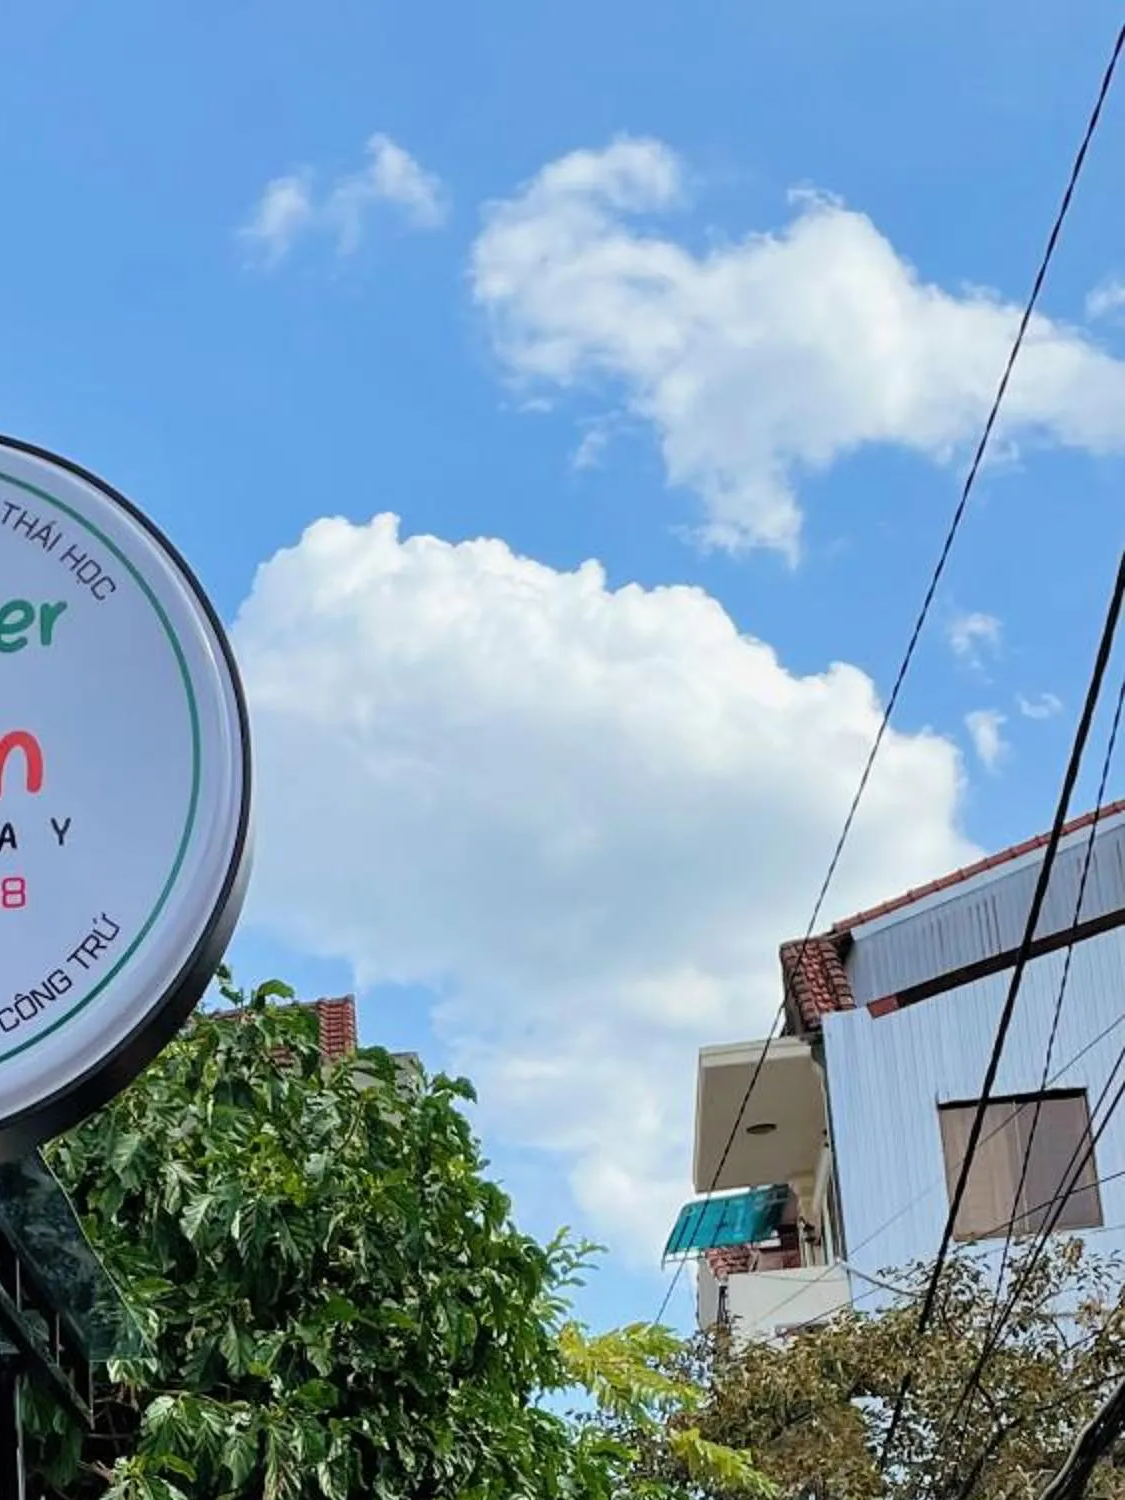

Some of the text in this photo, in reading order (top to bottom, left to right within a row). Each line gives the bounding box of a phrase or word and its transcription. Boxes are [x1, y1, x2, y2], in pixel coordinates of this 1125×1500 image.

[1, 501, 63, 553] THÁI
[59, 544, 117, 602] HỌC
[66, 911, 121, 970] TRỨ
